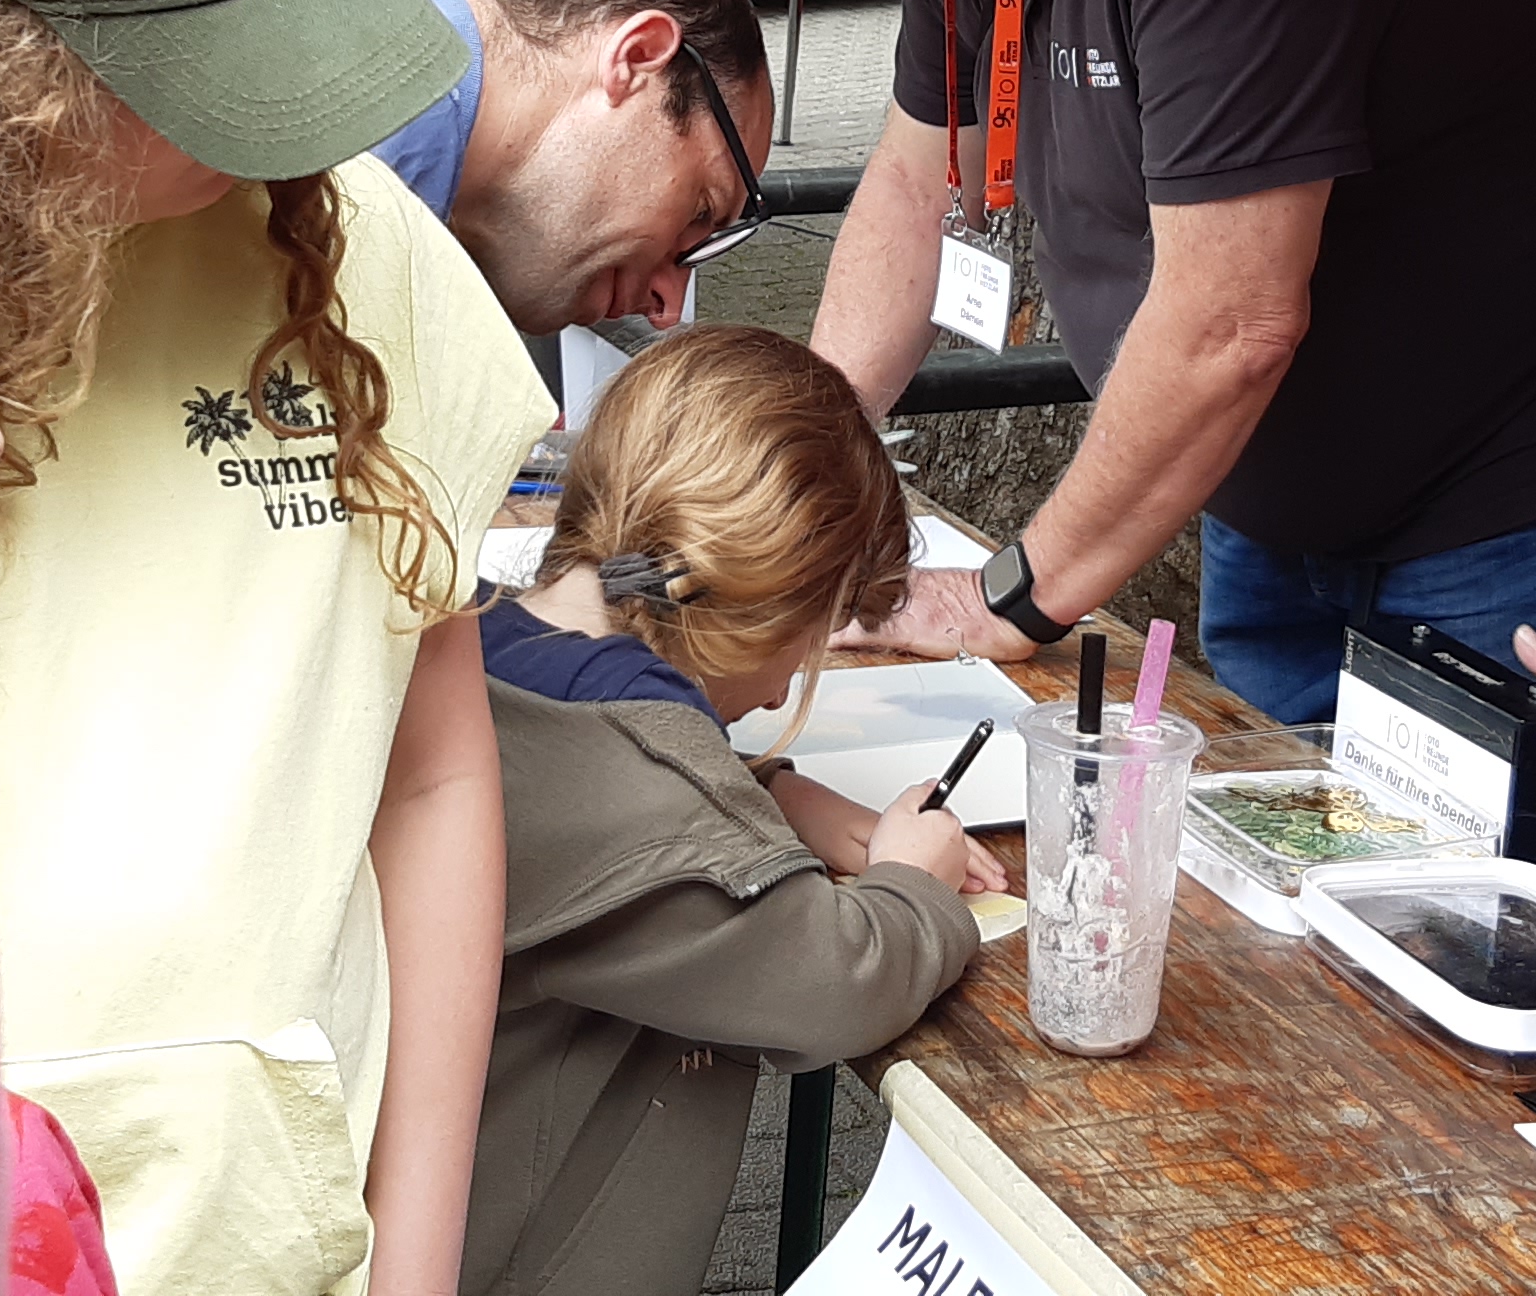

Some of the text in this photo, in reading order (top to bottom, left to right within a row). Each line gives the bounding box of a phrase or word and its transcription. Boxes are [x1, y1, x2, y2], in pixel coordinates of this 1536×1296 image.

[992, 106, 1011, 129] 95
[218, 451, 338, 488] summ
[1344, 740, 1488, 839] Danke für Ihre Spende!
